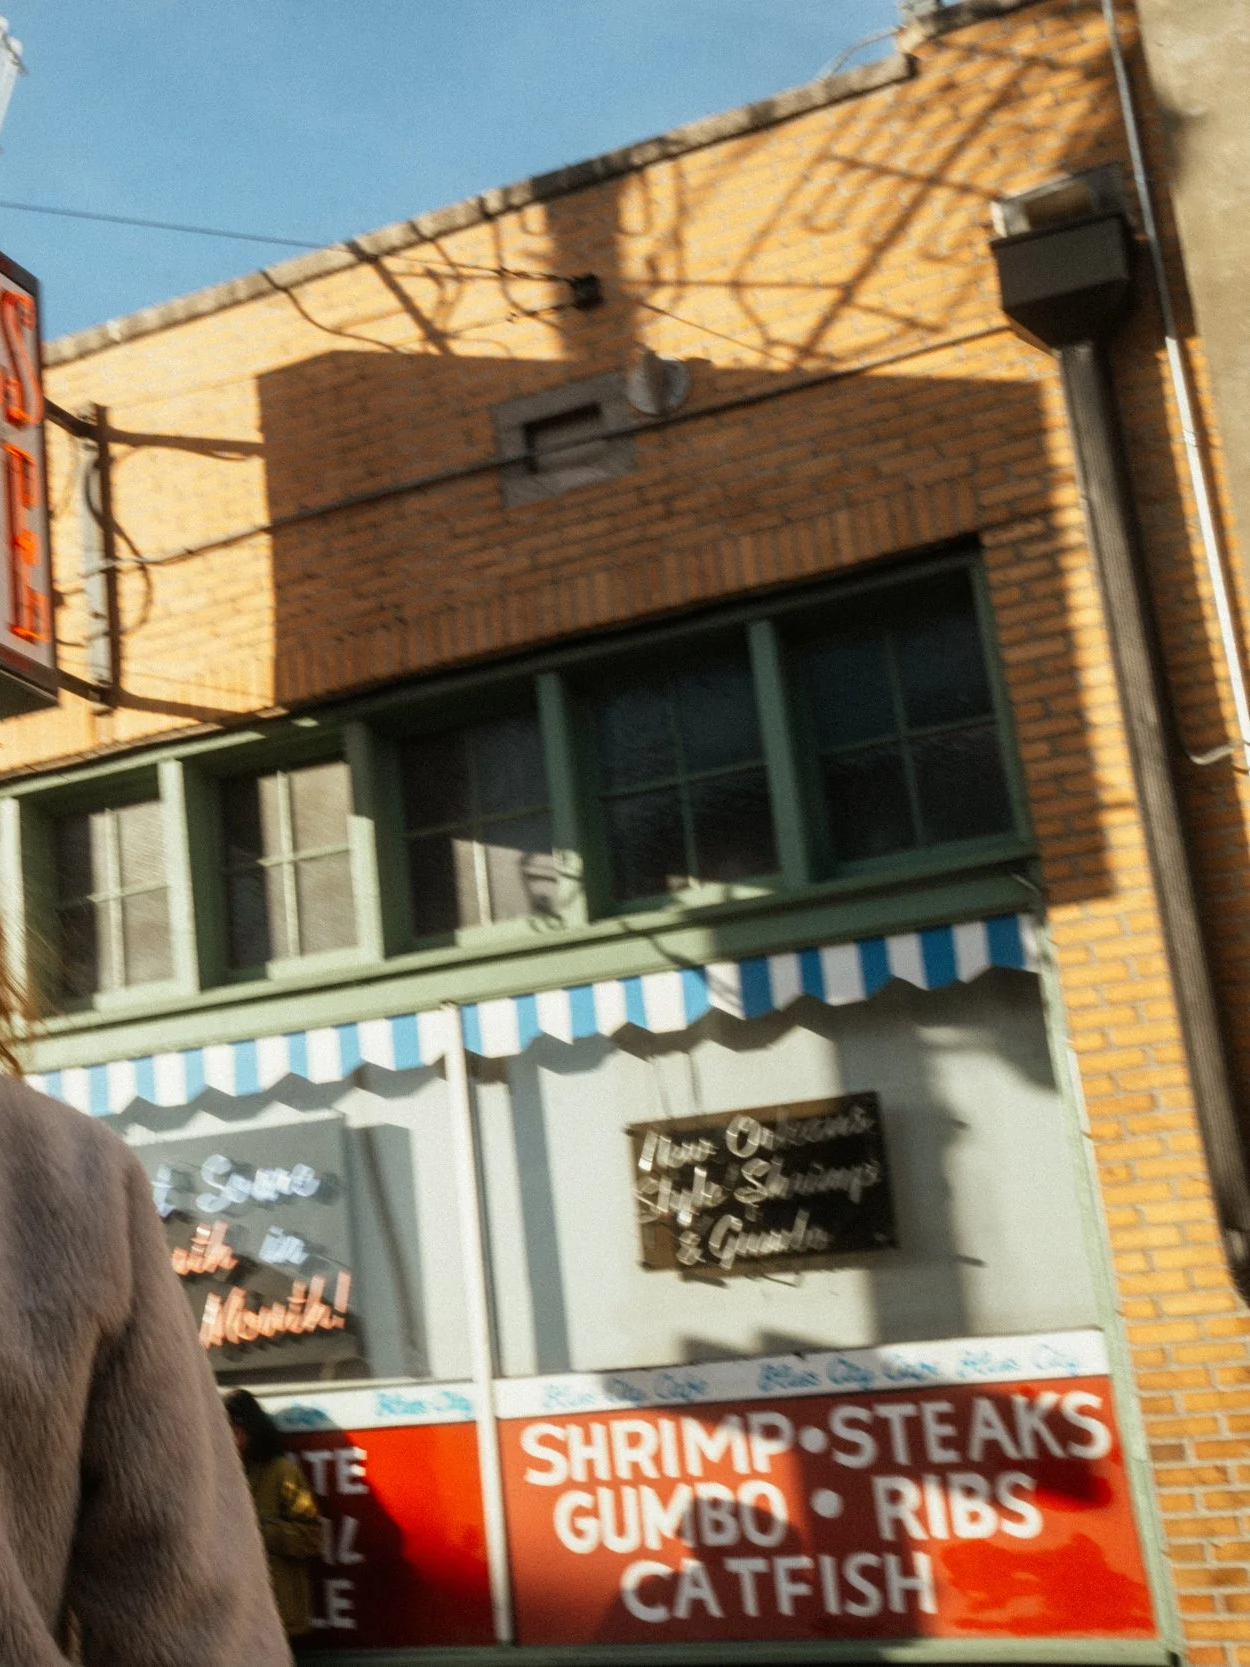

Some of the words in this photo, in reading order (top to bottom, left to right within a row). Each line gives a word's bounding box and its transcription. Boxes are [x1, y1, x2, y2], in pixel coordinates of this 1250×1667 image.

[196, 1154, 321, 1214] Some
[519, 1409, 796, 1487] SHRIMP
[829, 1389, 1113, 1470] STEAKS
[553, 1480, 789, 1554] GUMBO
[871, 1470, 1044, 1542] RIBS
[620, 1550, 939, 1624] CATFISH
